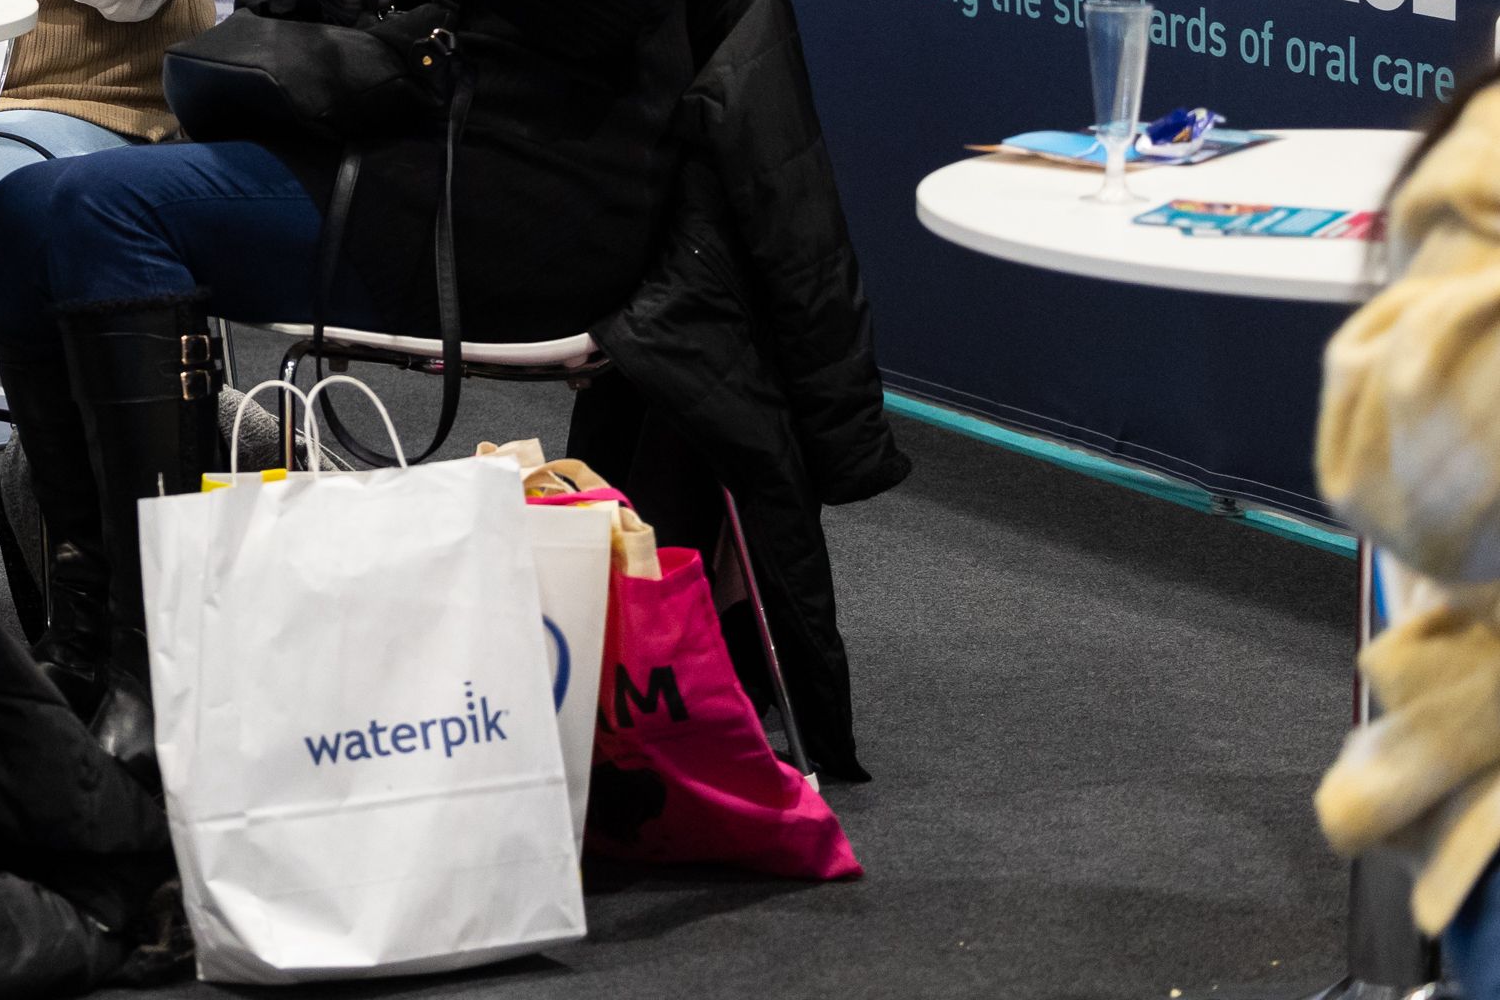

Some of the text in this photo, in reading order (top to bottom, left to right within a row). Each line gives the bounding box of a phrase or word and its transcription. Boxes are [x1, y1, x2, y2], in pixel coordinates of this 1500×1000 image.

[1240, 19, 1274, 68] of
[1286, 28, 1359, 85] oral
[1372, 53, 1456, 103] care
[304, 682, 508, 767] waterpik
